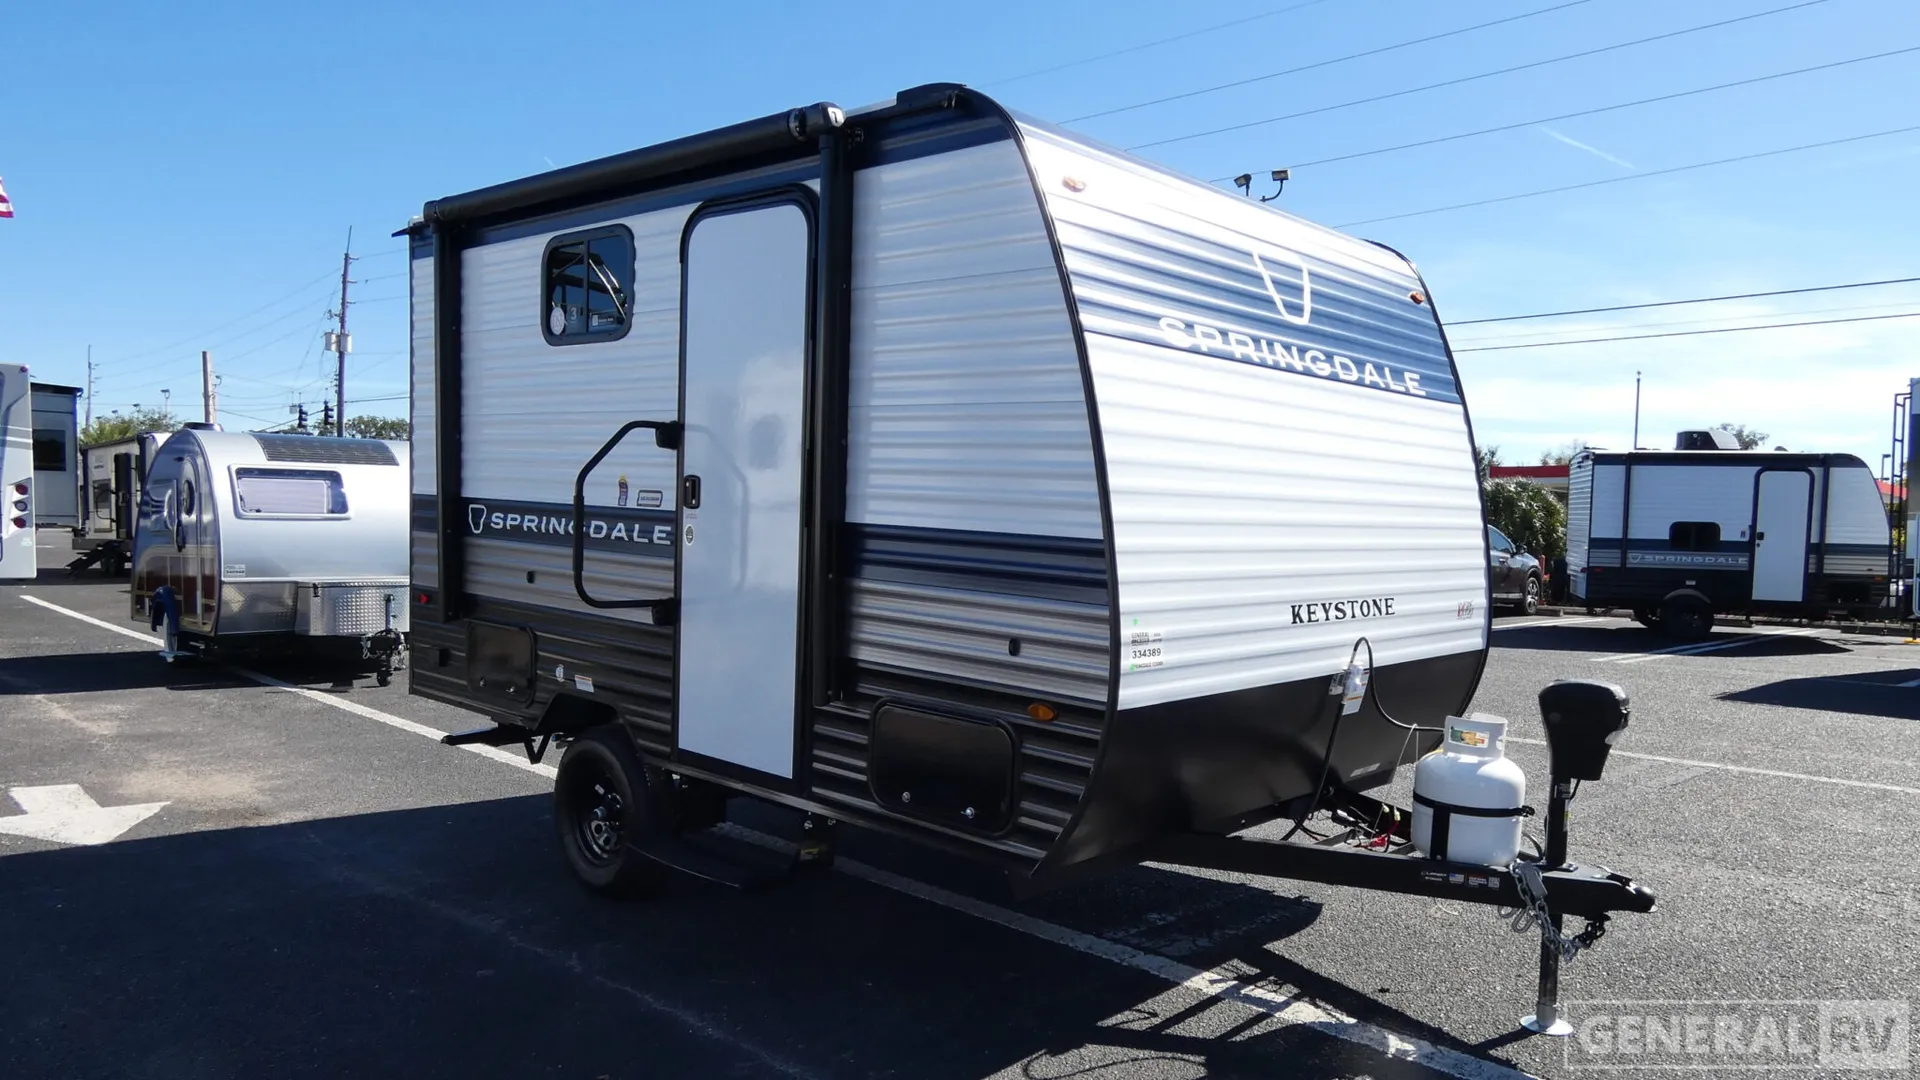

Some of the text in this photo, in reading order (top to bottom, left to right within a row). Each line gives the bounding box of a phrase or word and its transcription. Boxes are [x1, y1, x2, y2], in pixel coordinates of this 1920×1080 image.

[1159, 317, 1426, 395] SPRINGDALE
[1643, 555, 1748, 564] SPRINGDALE
[1290, 598, 1395, 624] KEYSTONE
[1132, 648, 1161, 659] 334389
